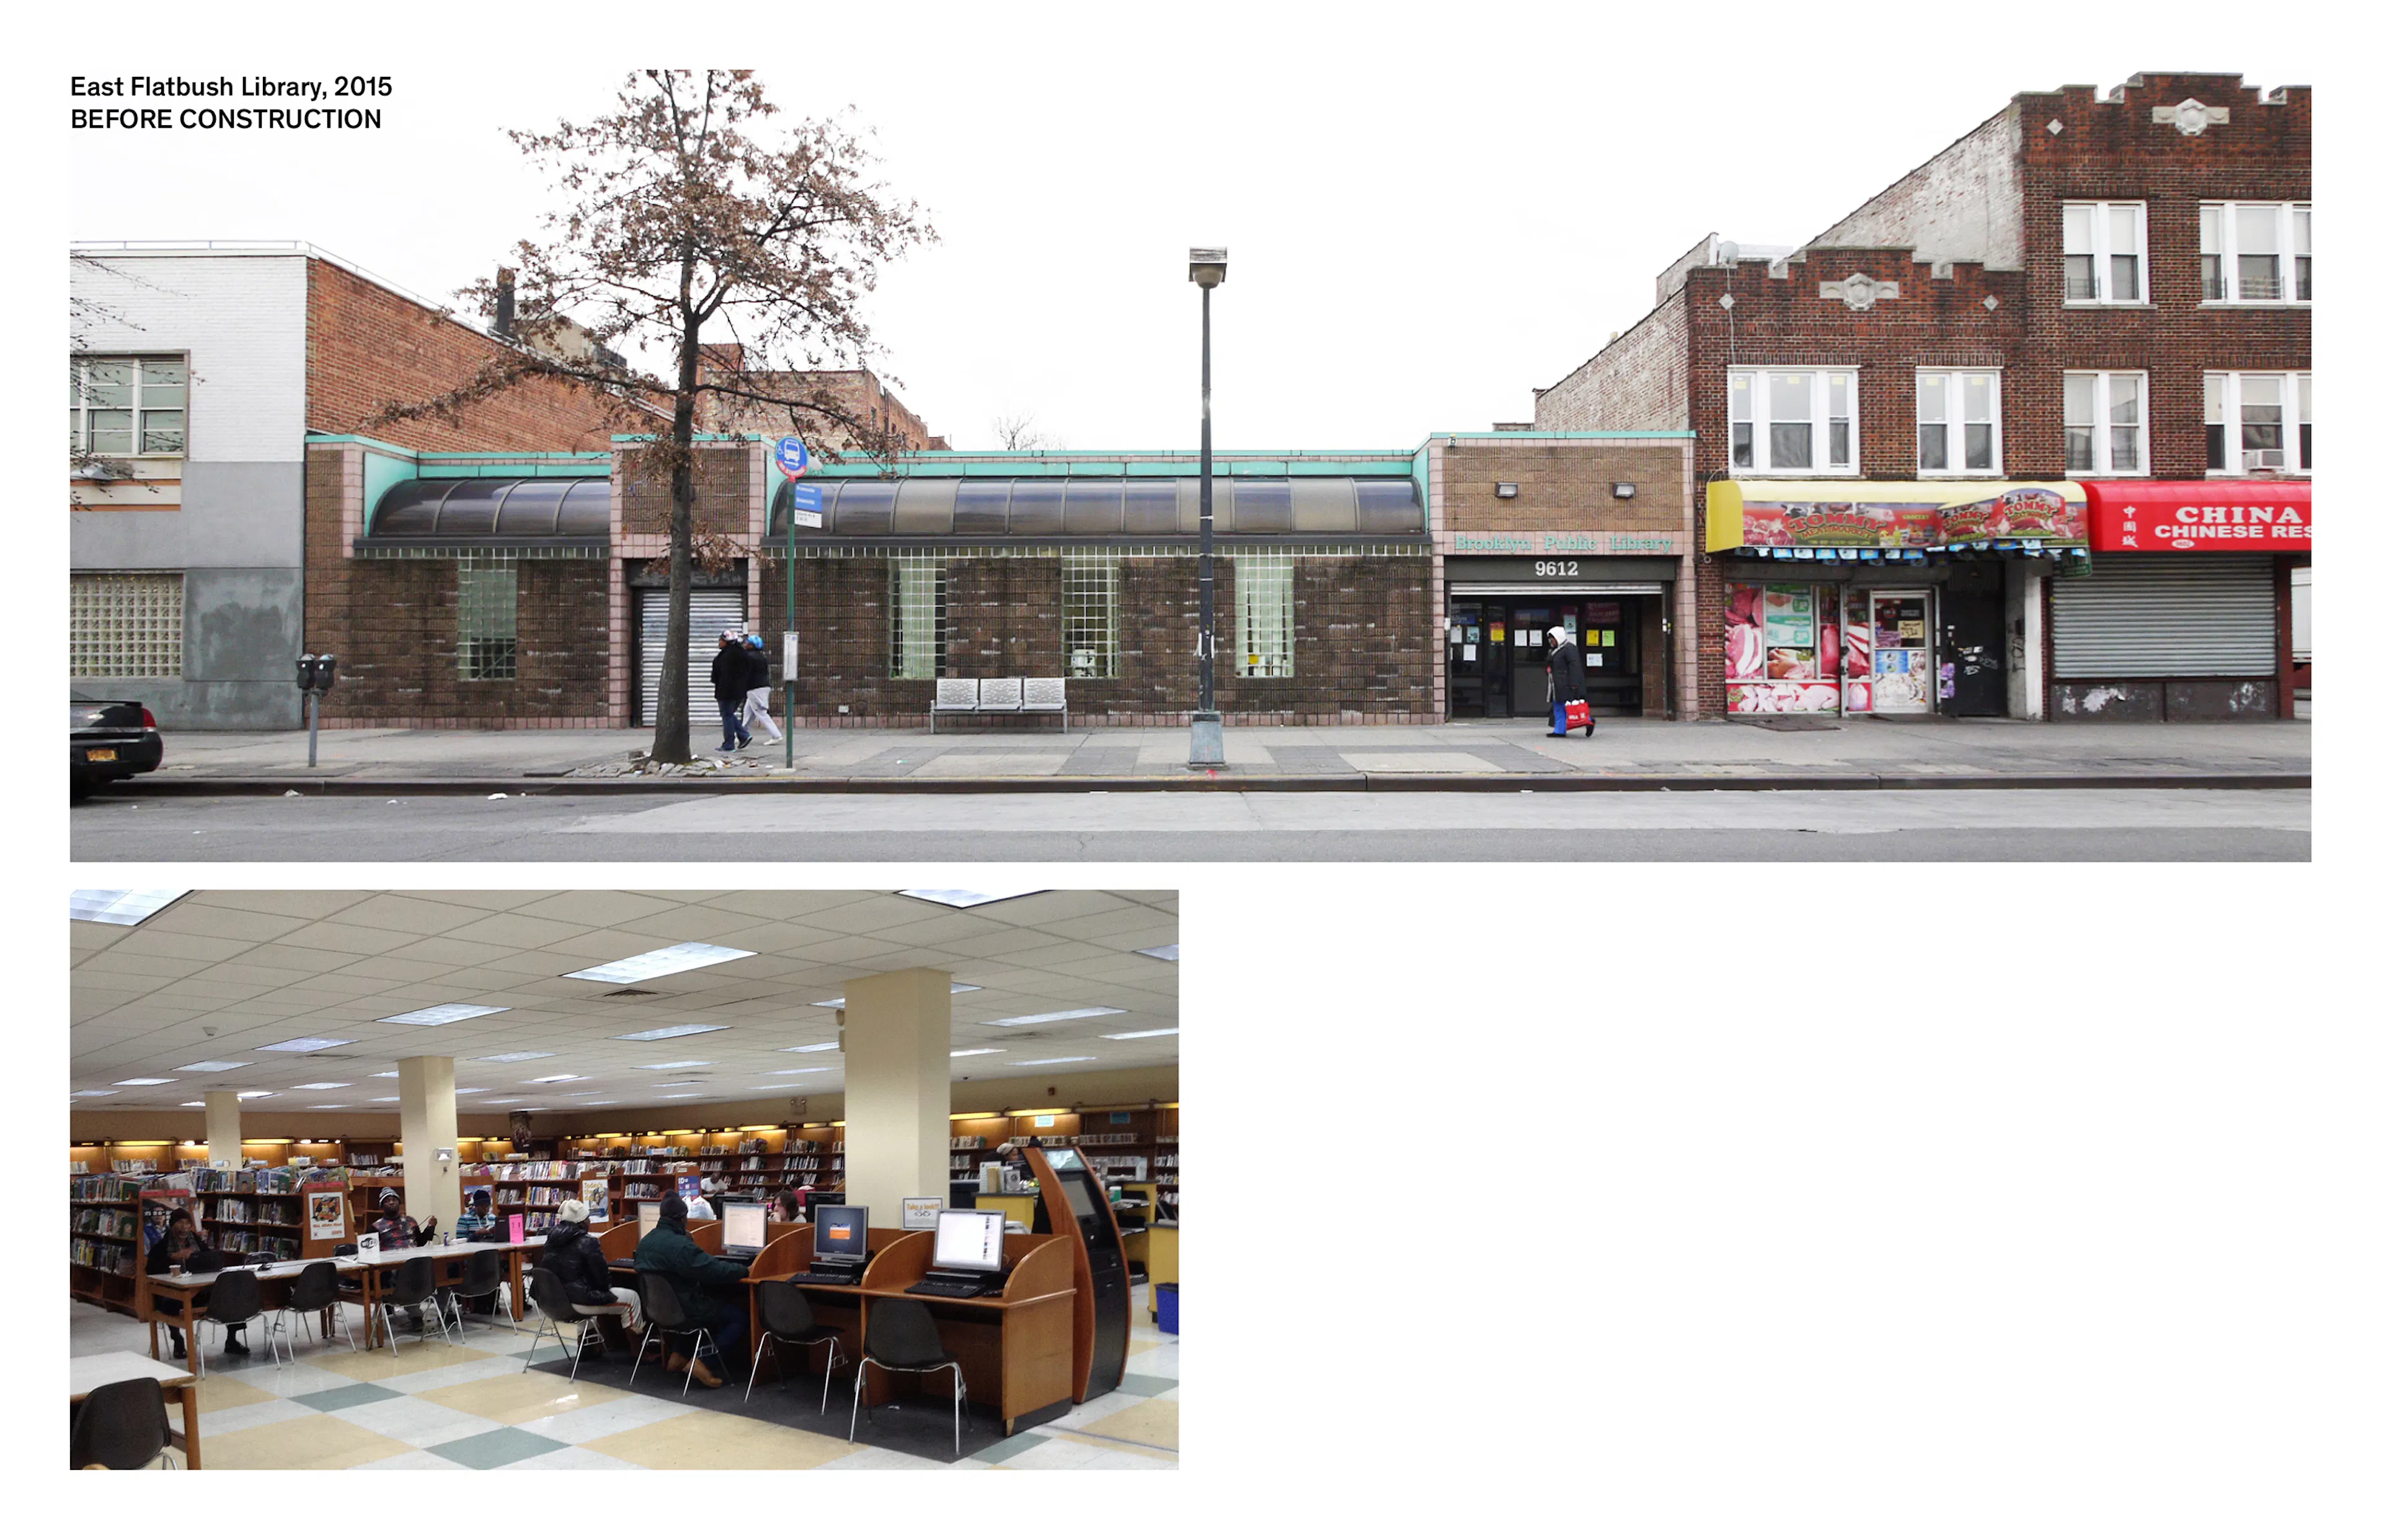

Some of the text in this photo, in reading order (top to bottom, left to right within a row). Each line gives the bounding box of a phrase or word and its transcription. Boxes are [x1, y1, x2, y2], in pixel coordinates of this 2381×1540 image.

[2004, 499, 2059, 517] TOMMY
[2176, 507, 2303, 523] CHINA
[1788, 511, 1887, 533] TOMMY
[1943, 510, 1990, 530] TOMMY
[1801, 526, 1871, 541] MEAT MARKET
[2155, 525, 2264, 538] CHINESE
[1455, 536, 1673, 553] Brooklyn Public Library
[1535, 561, 1579, 576] 9612
